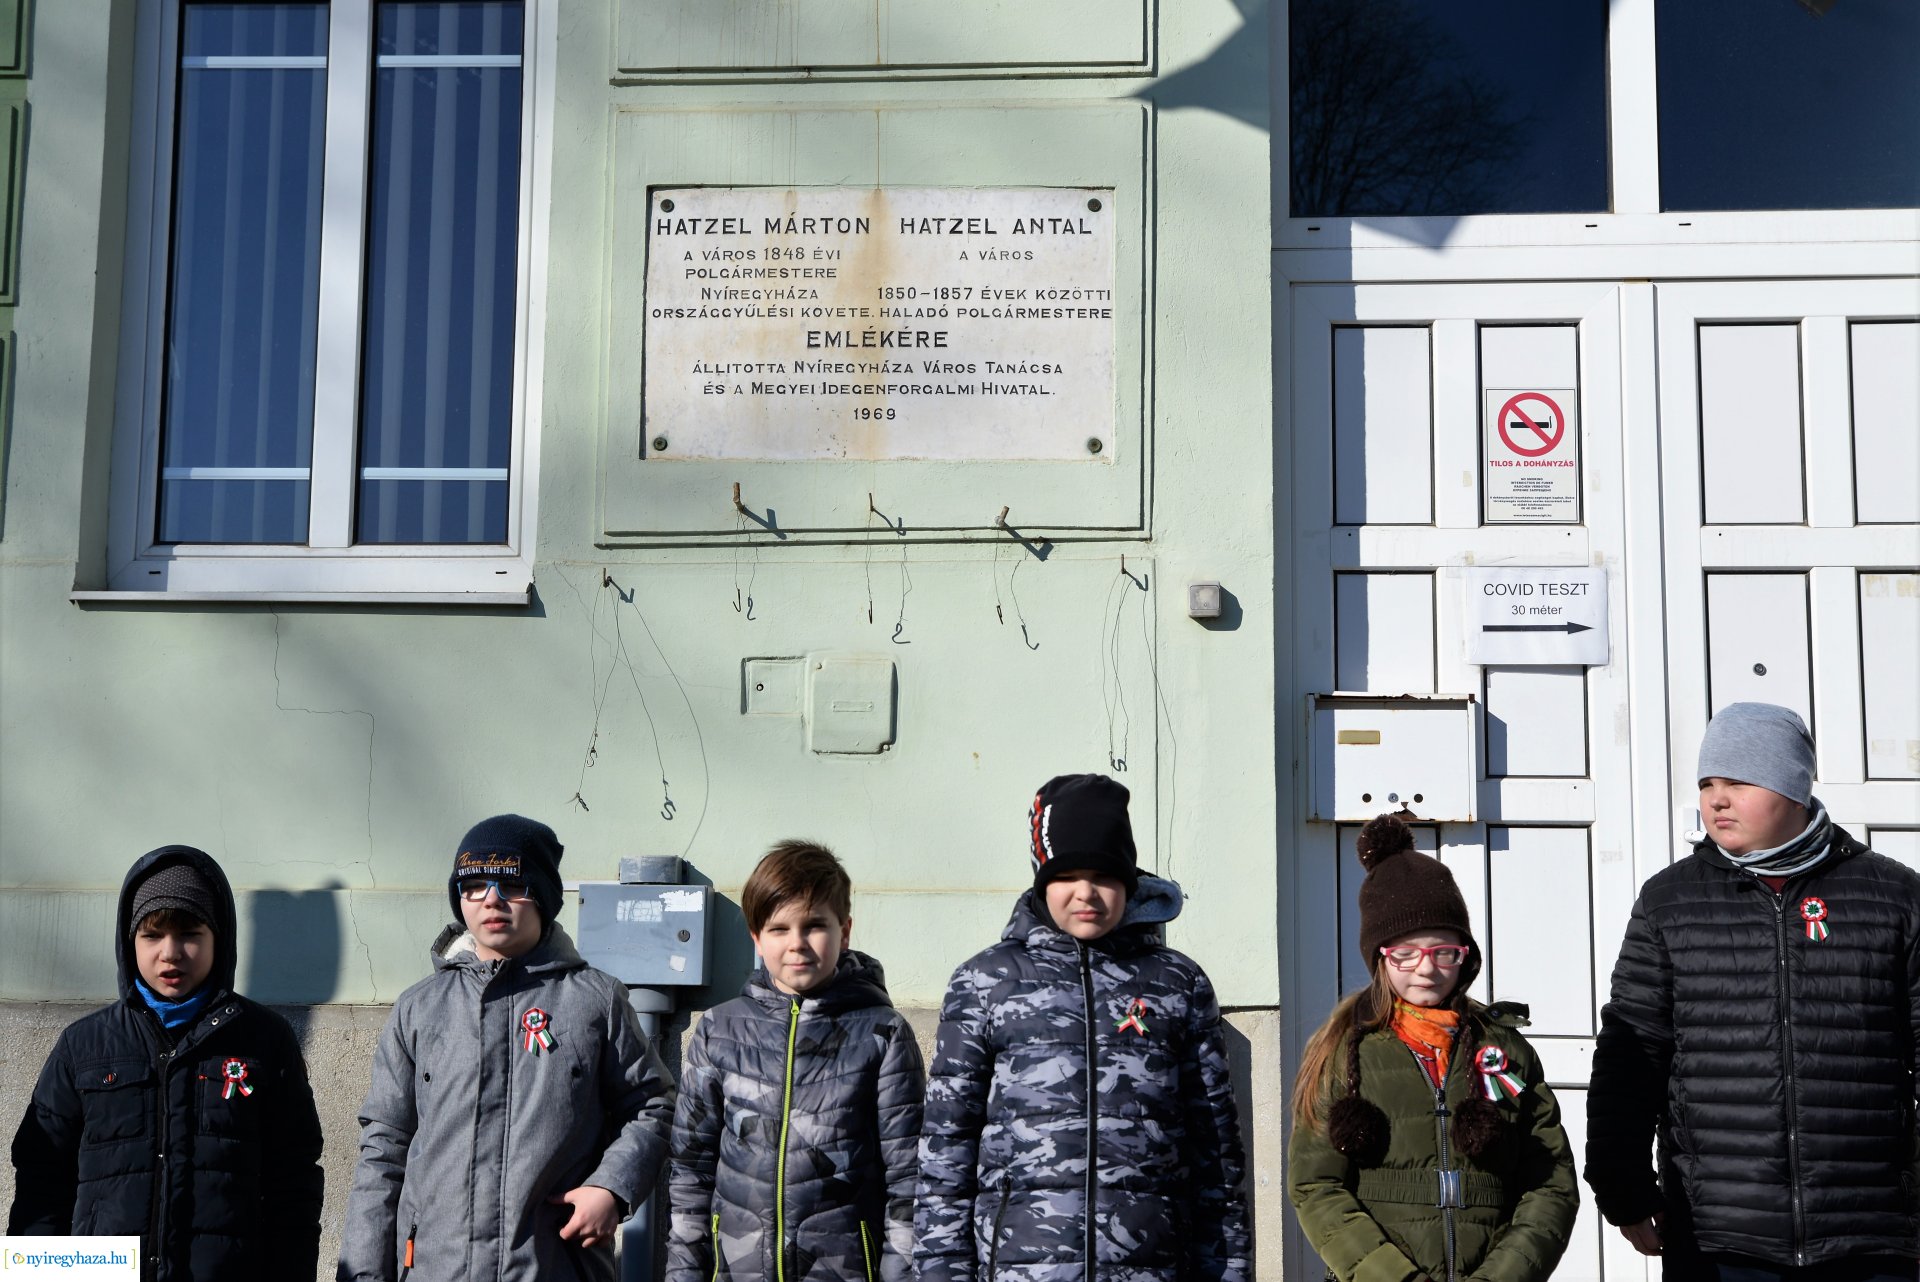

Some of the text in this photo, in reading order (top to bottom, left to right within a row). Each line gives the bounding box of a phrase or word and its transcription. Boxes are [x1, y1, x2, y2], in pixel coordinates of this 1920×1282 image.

[657, 211, 871, 235] HATZEL MÁRTON
[900, 217, 1093, 235] HATZEL ANTAL
[683, 246, 842, 261] A VÁROS 1848 ÉVI
[959, 246, 1035, 261] A VÁROS
[685, 264, 838, 279] POLGÁRMESTERE
[701, 286, 819, 300] NYÍREGYHÁZA
[981, 285, 1028, 300] ÉVEK
[652, 304, 794, 319] ORSZÁGGYŰLÉSI
[880, 303, 1113, 319] HALADÓ POLGÁRMESTERE
[807, 326, 948, 348] EMLÉKÉRE
[794, 358, 914, 374] NYÍREGYHÁZA
[923, 359, 977, 374] VÁROS
[985, 360, 1064, 374] TANÁCSA
[703, 381, 1057, 395] ÉS A MEGYEI IDEGENFORGALMI HIVATAL.
[853, 407, 897, 420] 1969
[1523, 459, 1574, 467] DOHÁNYZÁS
[1484, 583, 1589, 596] COVID TESZT
[1511, 605, 1563, 615] 30 méter
[483, 866, 500, 874] SINCE
